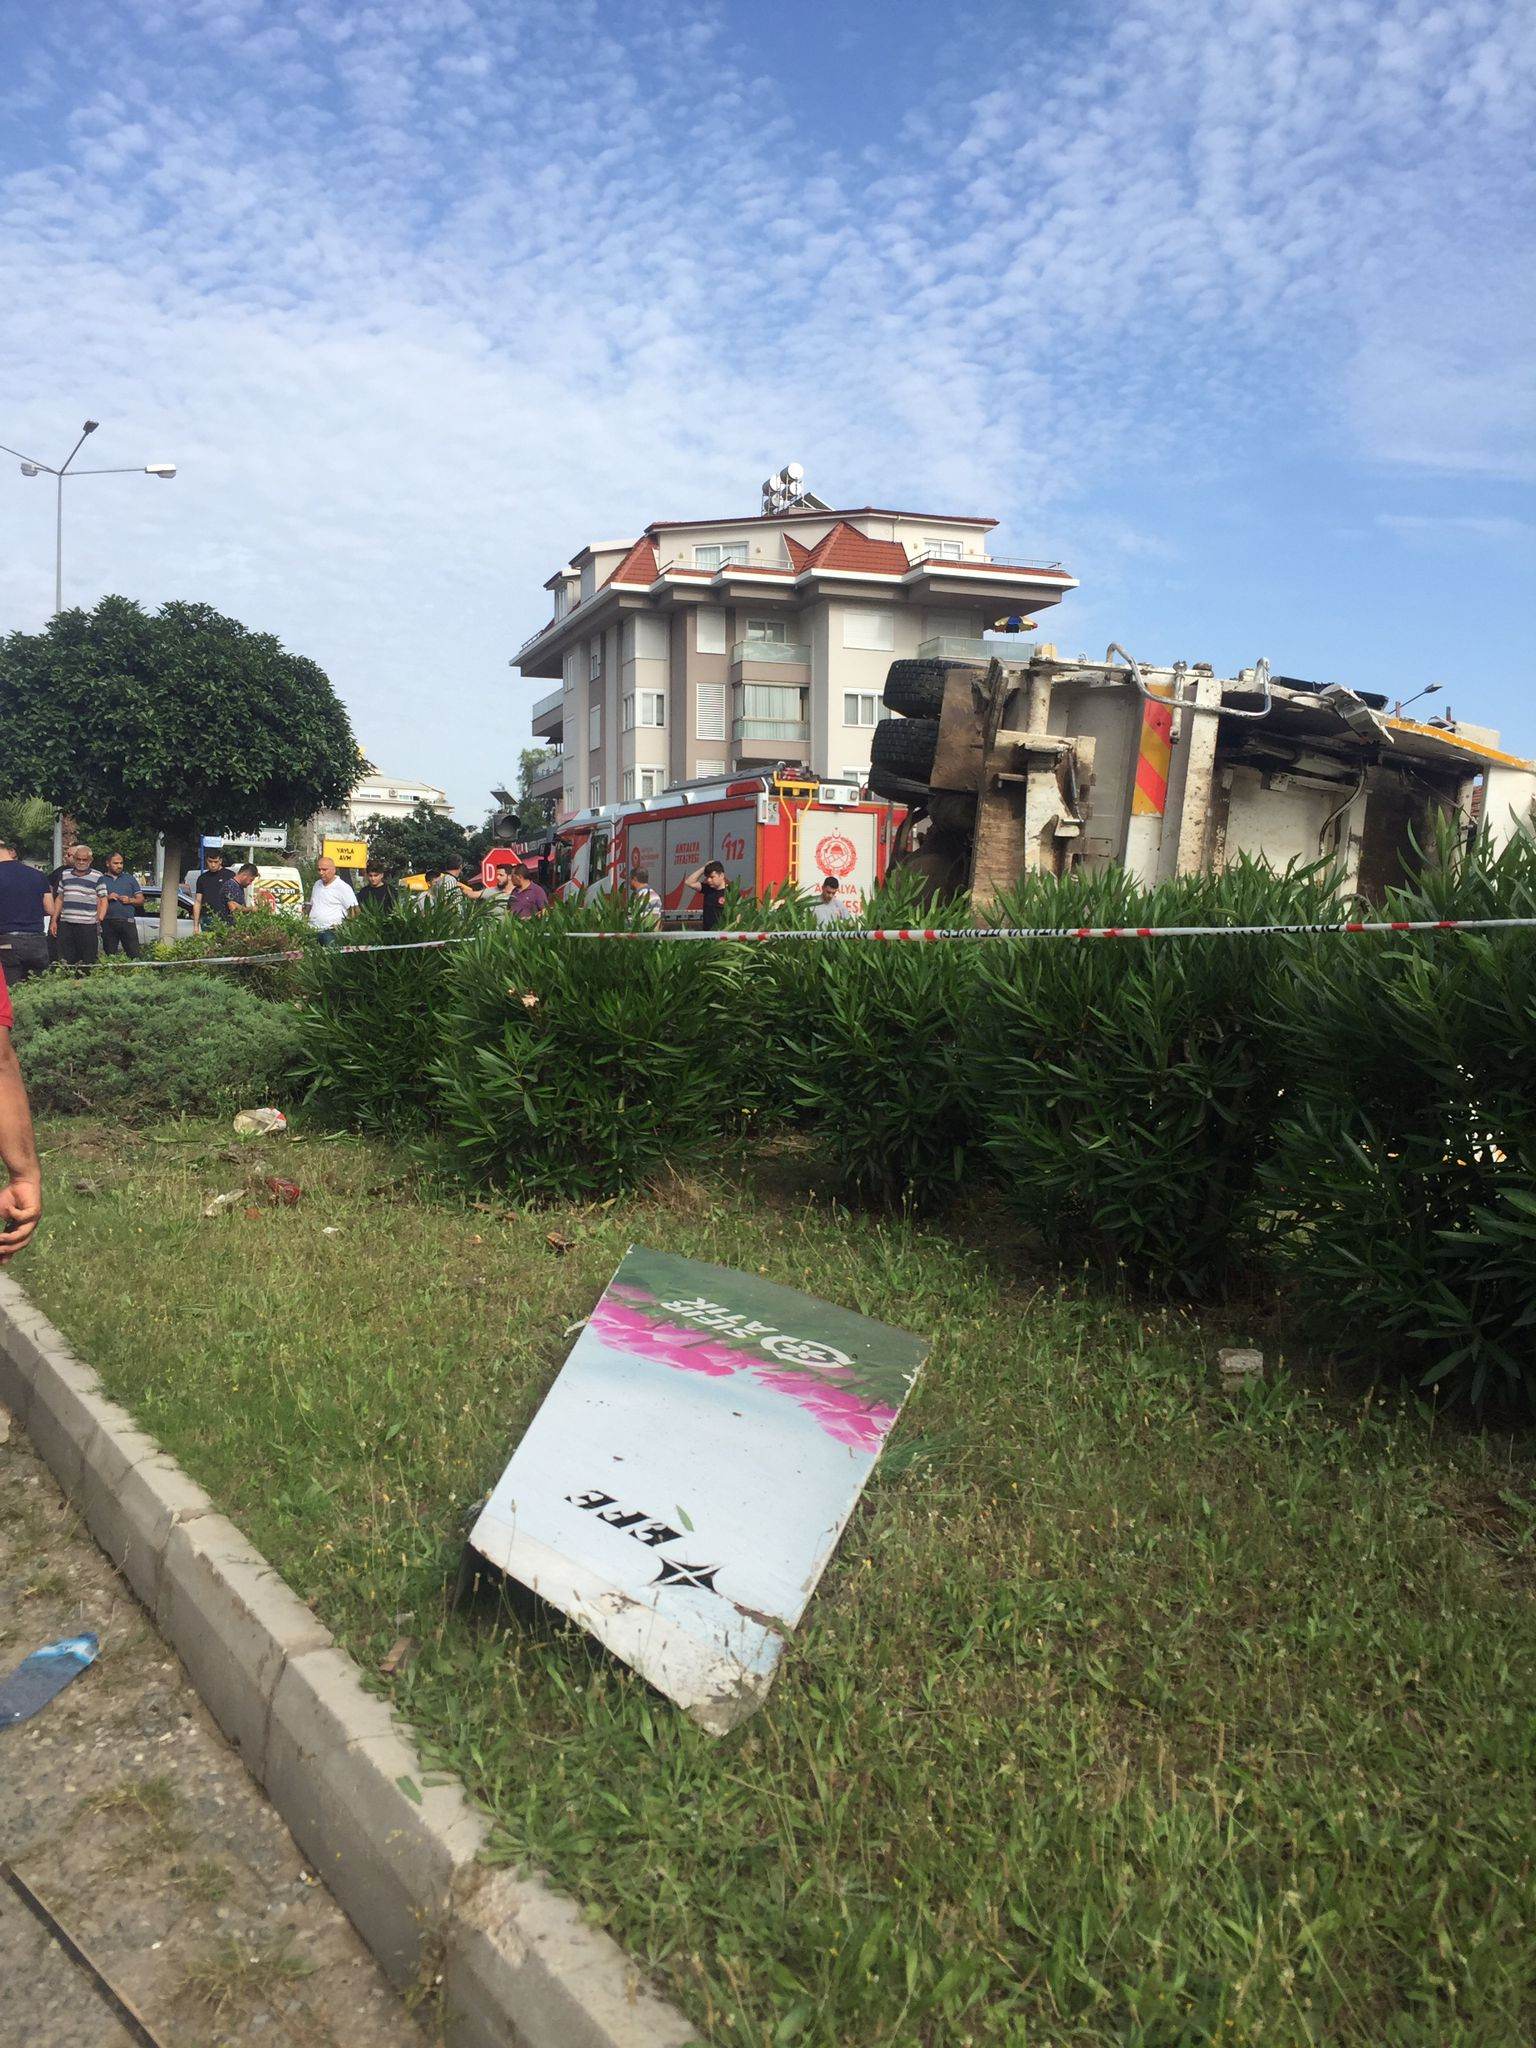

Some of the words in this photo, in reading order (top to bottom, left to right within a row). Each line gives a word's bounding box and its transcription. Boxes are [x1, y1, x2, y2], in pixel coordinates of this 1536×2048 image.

[336, 847, 355, 855] YAYLA
[675, 842, 700, 854] ANTALYA
[724, 838, 745, 861] 112
[815, 882, 857, 895] AALYA
[660, 1300, 757, 1339] SIFIR
[679, 1297, 779, 1333] ATIK
[563, 1490, 684, 1547] EFE
